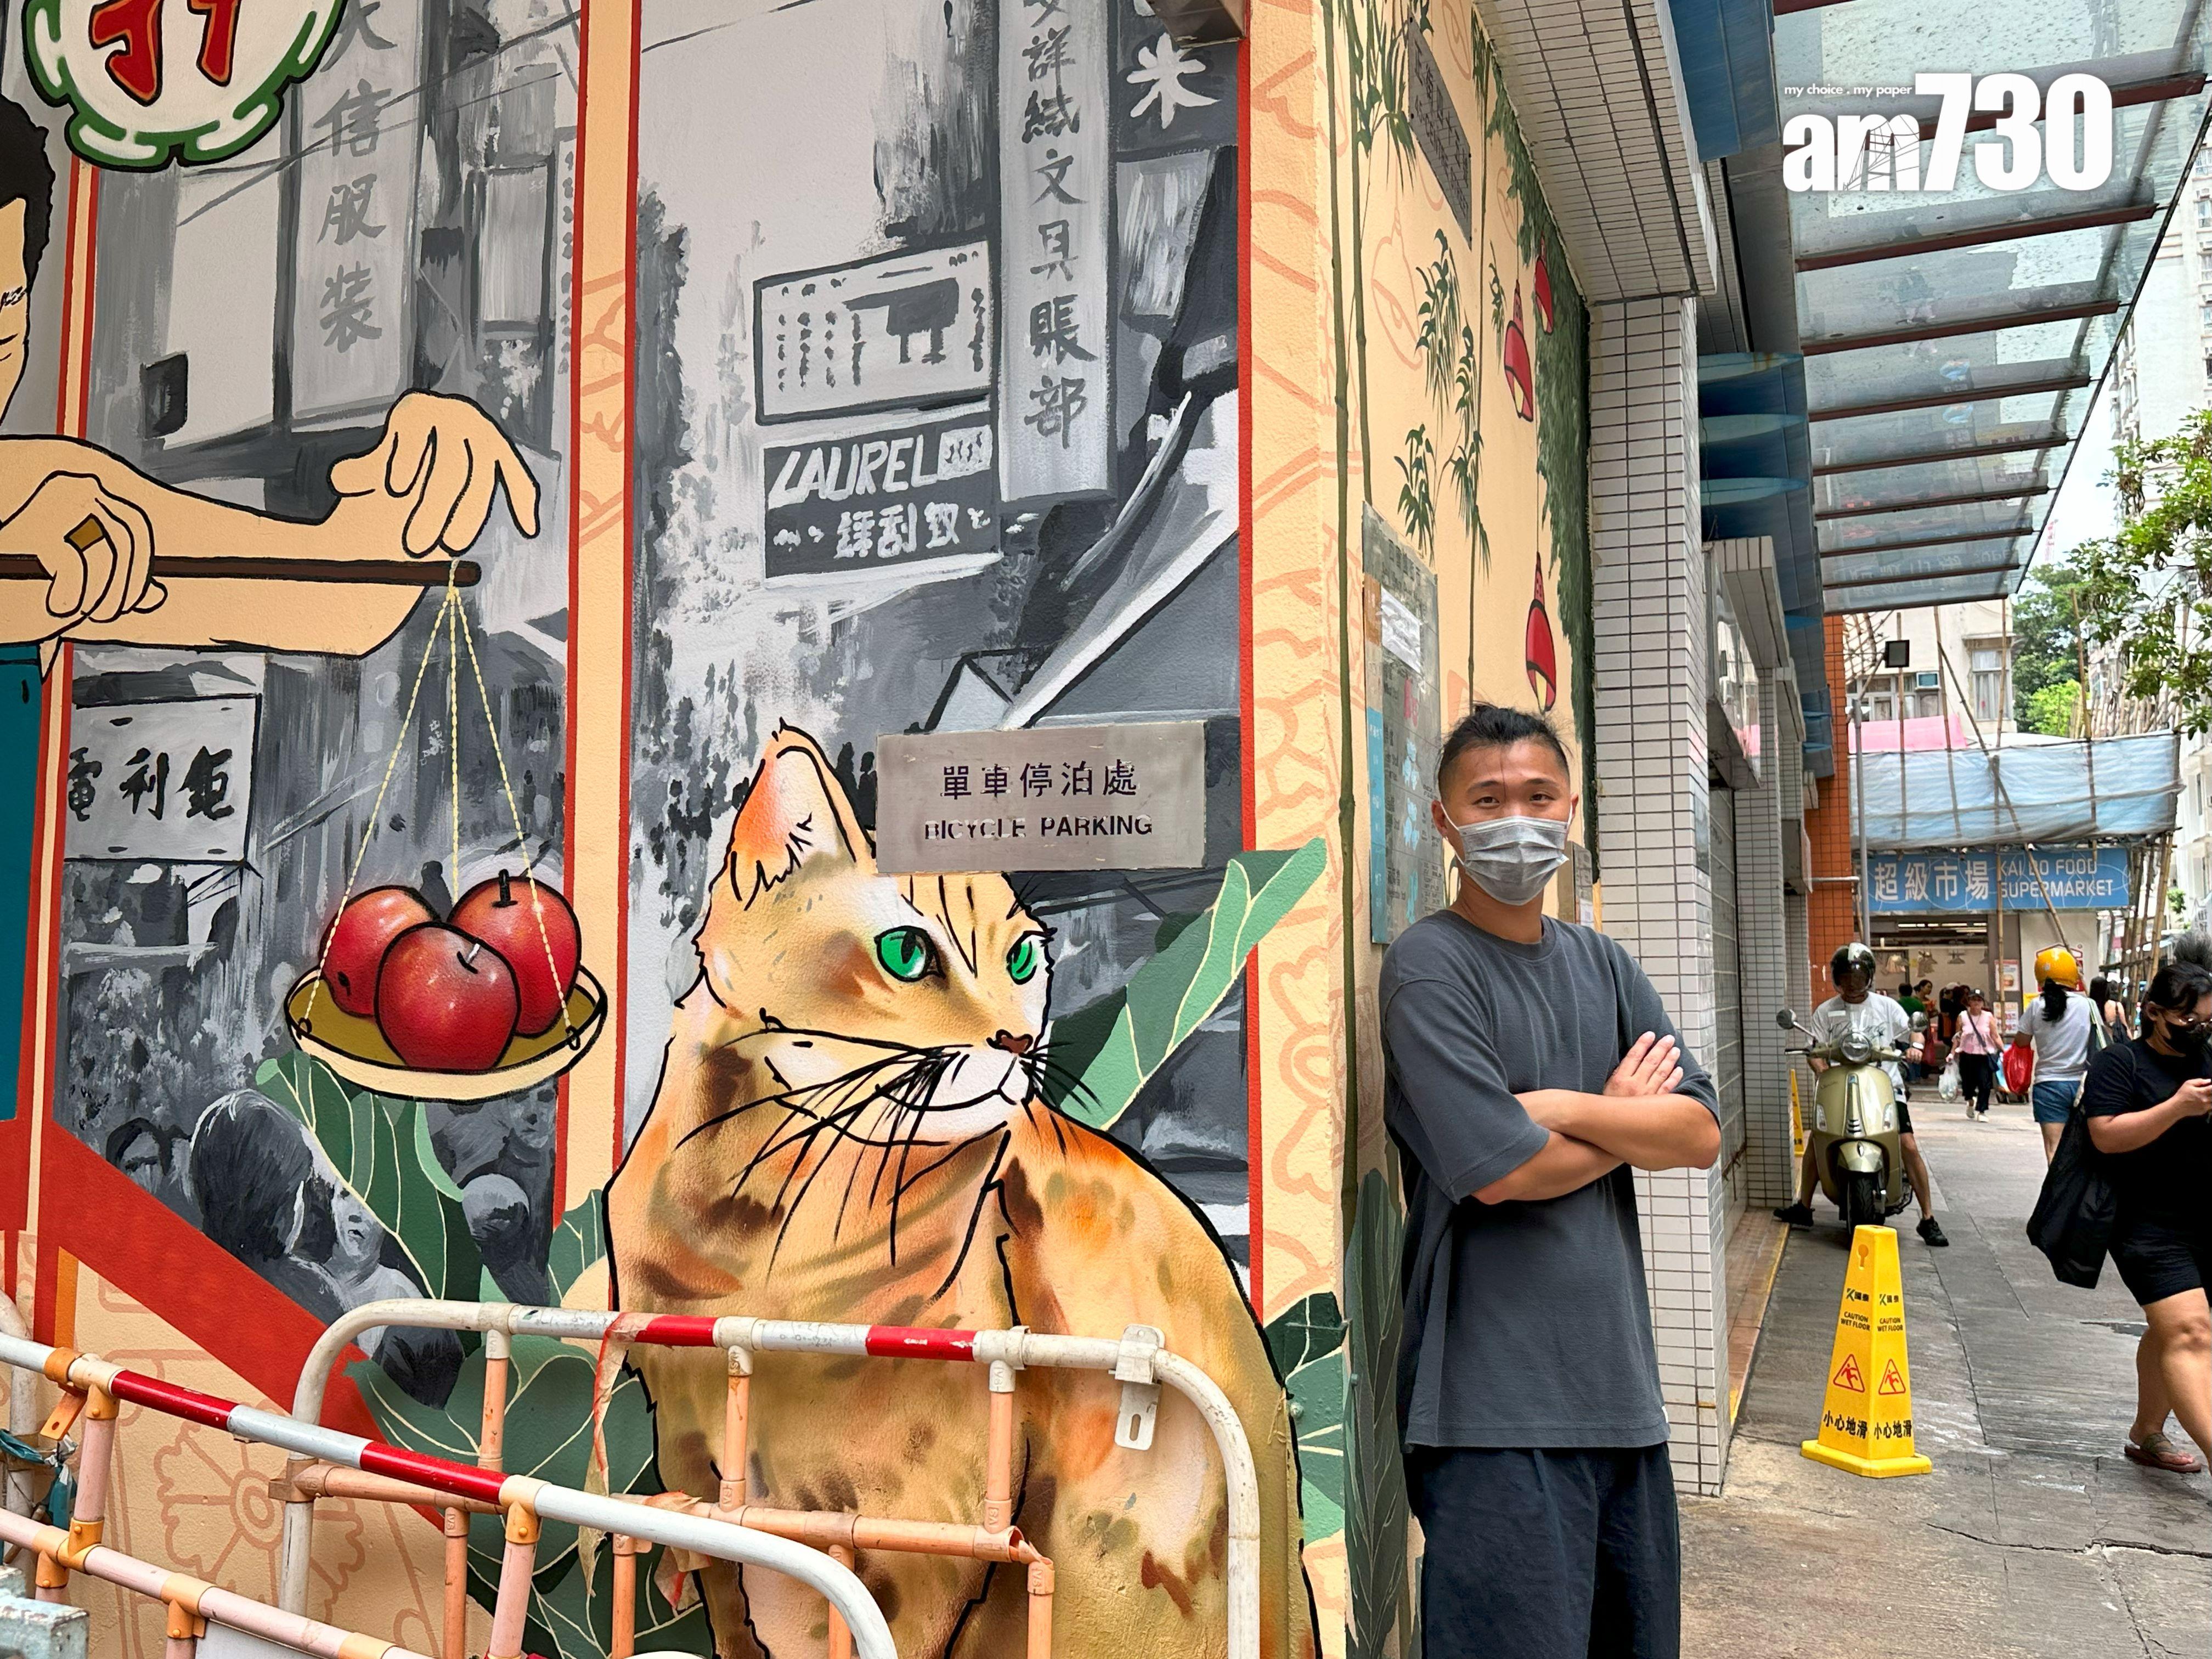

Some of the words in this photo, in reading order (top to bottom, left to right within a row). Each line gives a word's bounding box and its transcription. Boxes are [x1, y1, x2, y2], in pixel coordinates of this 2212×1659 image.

[768, 434, 938, 510] LAUREL
[941, 759, 1139, 800] 單車停泊處
[924, 817, 1026, 839] BICYCLE
[1041, 815, 1152, 837] PARKING
[2056, 858, 2097, 875] FOOD
[1874, 860, 1989, 902] 超級市場
[2001, 879, 2113, 898] SUPERMARKET
[1844, 1311, 1869, 1323] CAUTION
[1853, 1321, 1870, 1331] FLOOR
[1823, 1409, 1868, 1440] 小心地滑
[1874, 1419, 1912, 1440] 小心地滑
